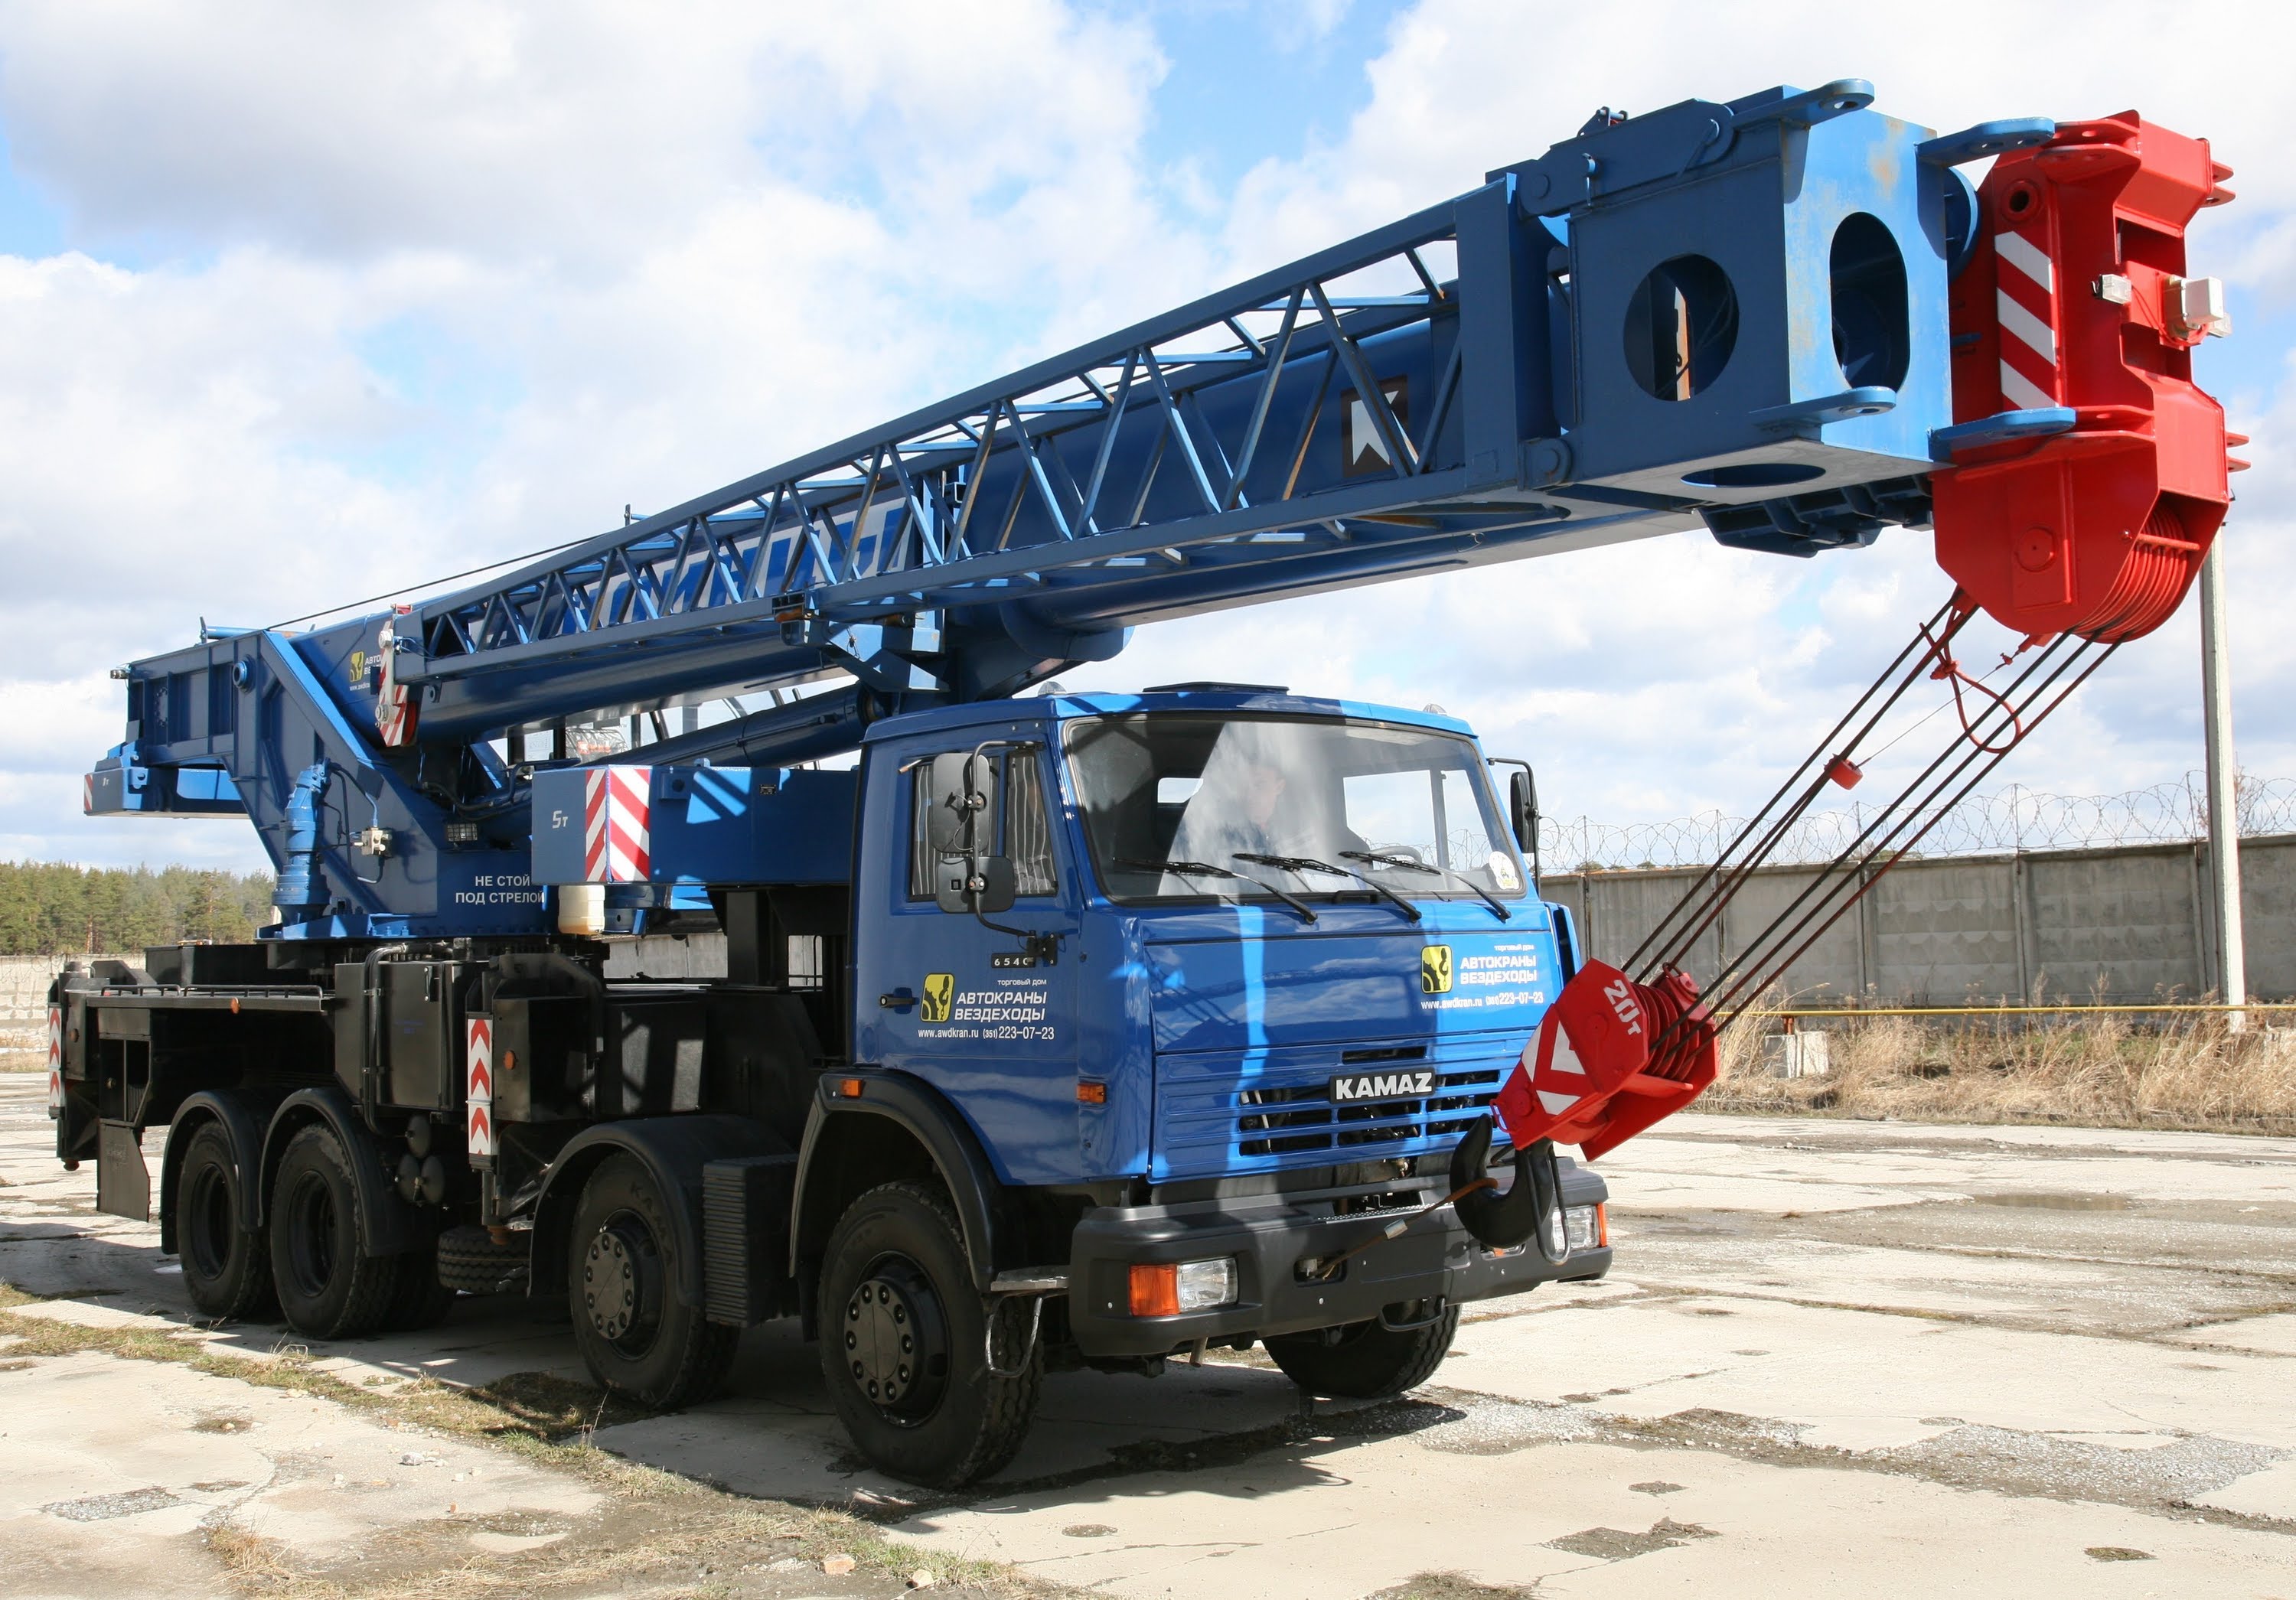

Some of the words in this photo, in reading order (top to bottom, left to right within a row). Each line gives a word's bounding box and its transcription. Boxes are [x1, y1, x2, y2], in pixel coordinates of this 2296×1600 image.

[475, 876, 493, 886] НЕ
[497, 875, 530, 886] СТОЙ
[455, 892, 485, 904] ПОД
[489, 891, 545, 903] СТРЕЛОЙ
[1460, 955, 1536, 969] АВТОКРАНЫ
[1460, 969, 1538, 986] ВЕЗДЕХОДЫ
[957, 991, 1047, 1004] АВТОКРАНЫ
[1420, 997, 1482, 1010] www.awdkran.ru
[954, 1008, 1045, 1023] ВЕЗДЕХОДЫ
[918, 1027, 979, 1038] www.awdkran.ru
[1336, 1072, 1433, 1100] KAMAZ
